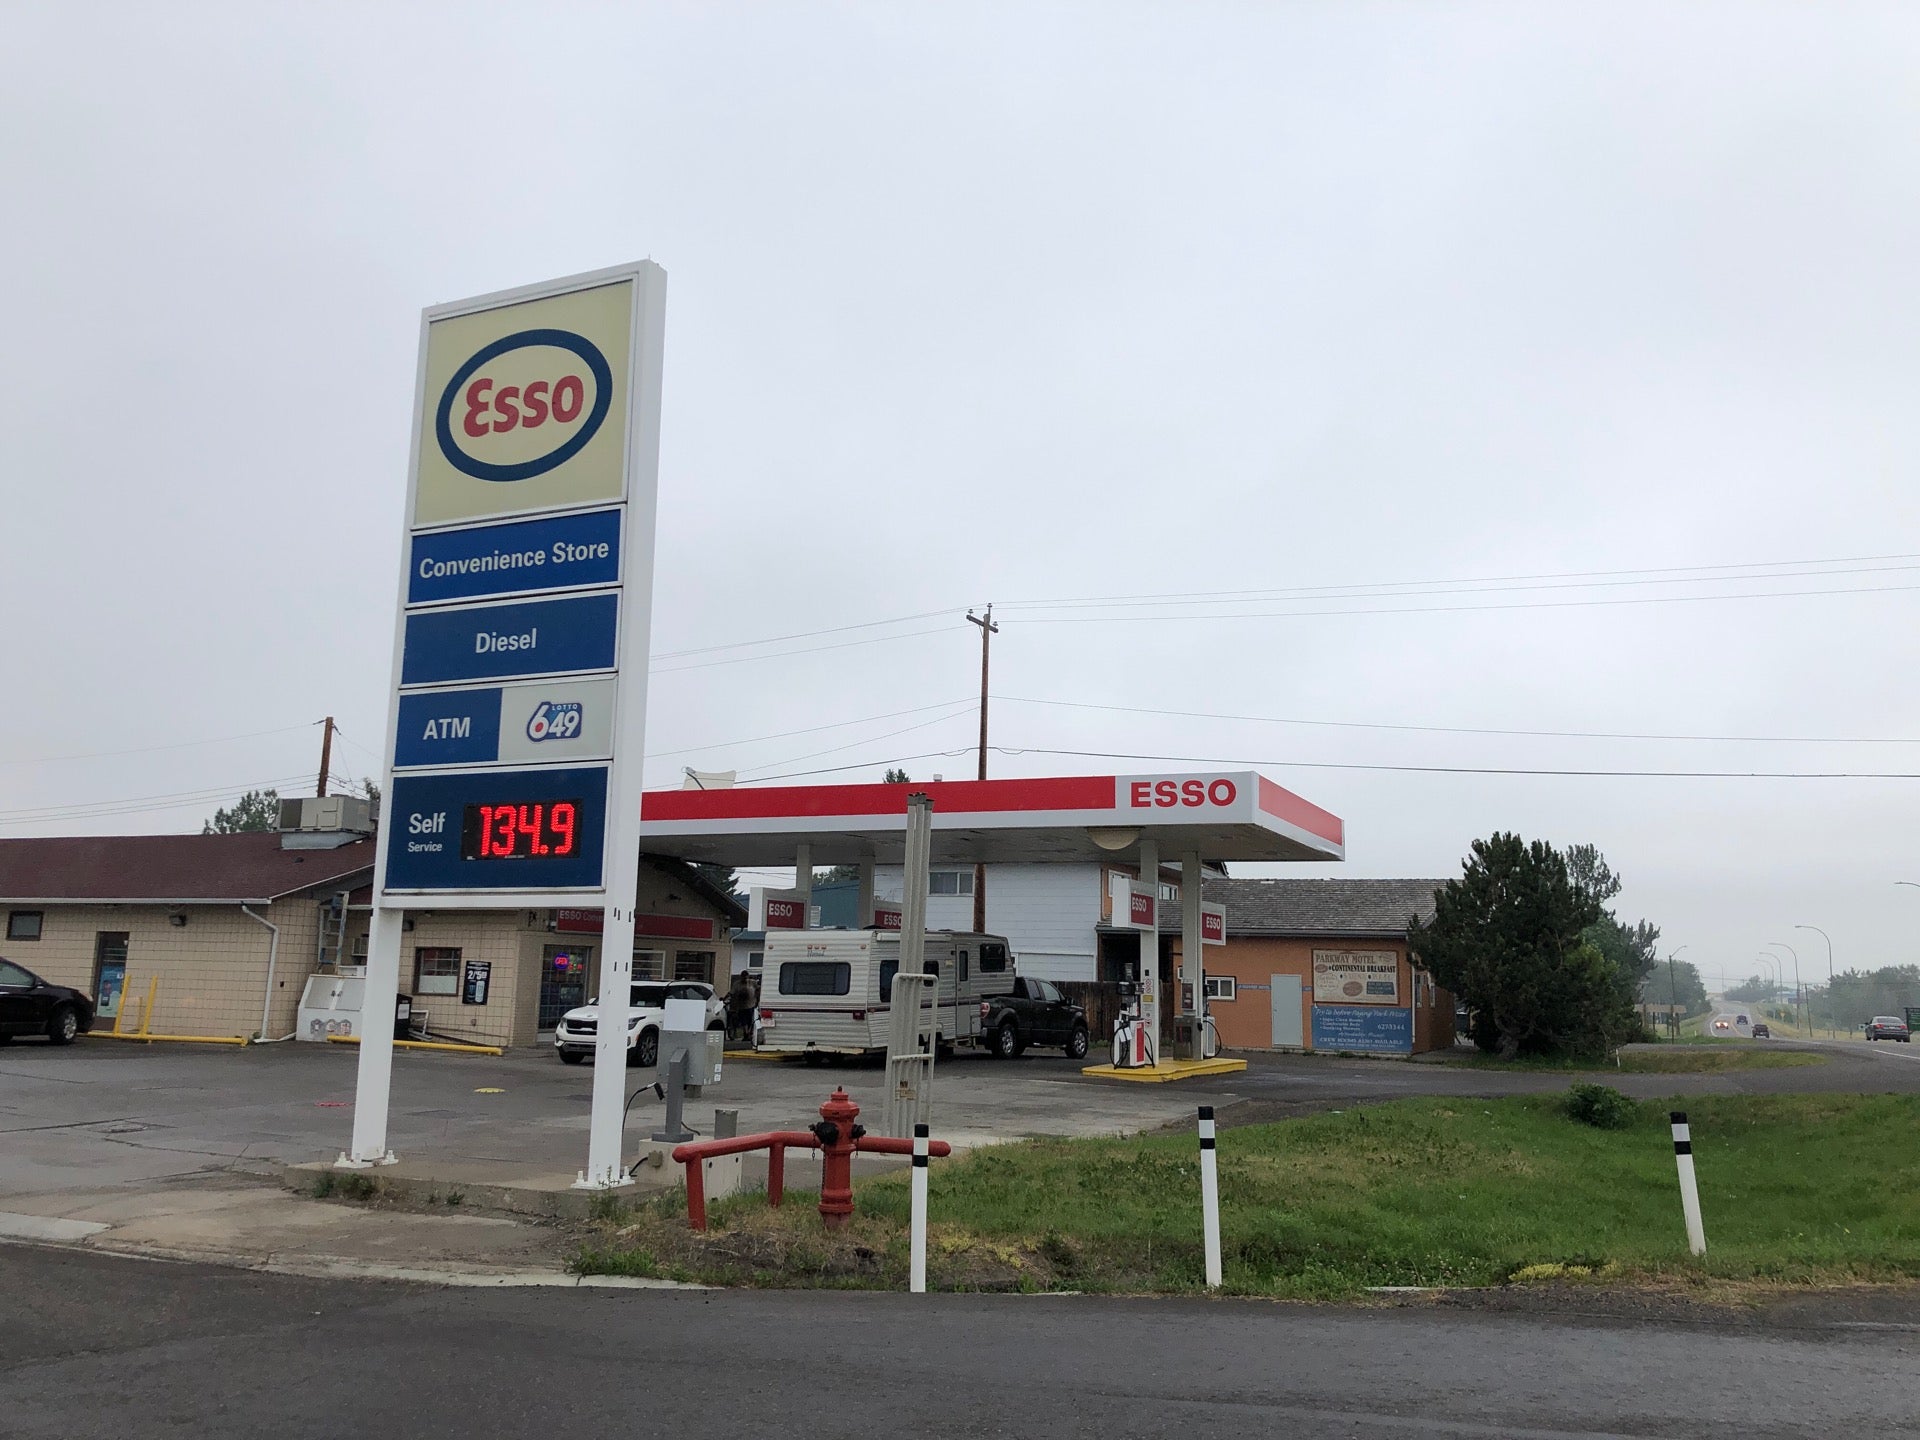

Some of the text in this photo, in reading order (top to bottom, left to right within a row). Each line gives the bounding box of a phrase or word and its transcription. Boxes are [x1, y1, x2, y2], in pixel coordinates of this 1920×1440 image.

[420, 542, 609, 579] Convenience Store
[475, 628, 537, 654] Diesel
[423, 717, 471, 740] ATM
[1130, 778, 1237, 808] ESSO
[408, 812, 446, 834] Self
[480, 803, 575, 856] 134.9
[408, 841, 443, 852] Service
[768, 902, 793, 917] ESSO
[1132, 896, 1147, 912] ESSO
[560, 910, 581, 920] ESSO
[1206, 916, 1220, 930] ESSO
[1316, 954, 1350, 964] PARKWAY
[1352, 955, 1376, 965] MOTEL
[1367, 965, 1396, 973] BREAKFAST
